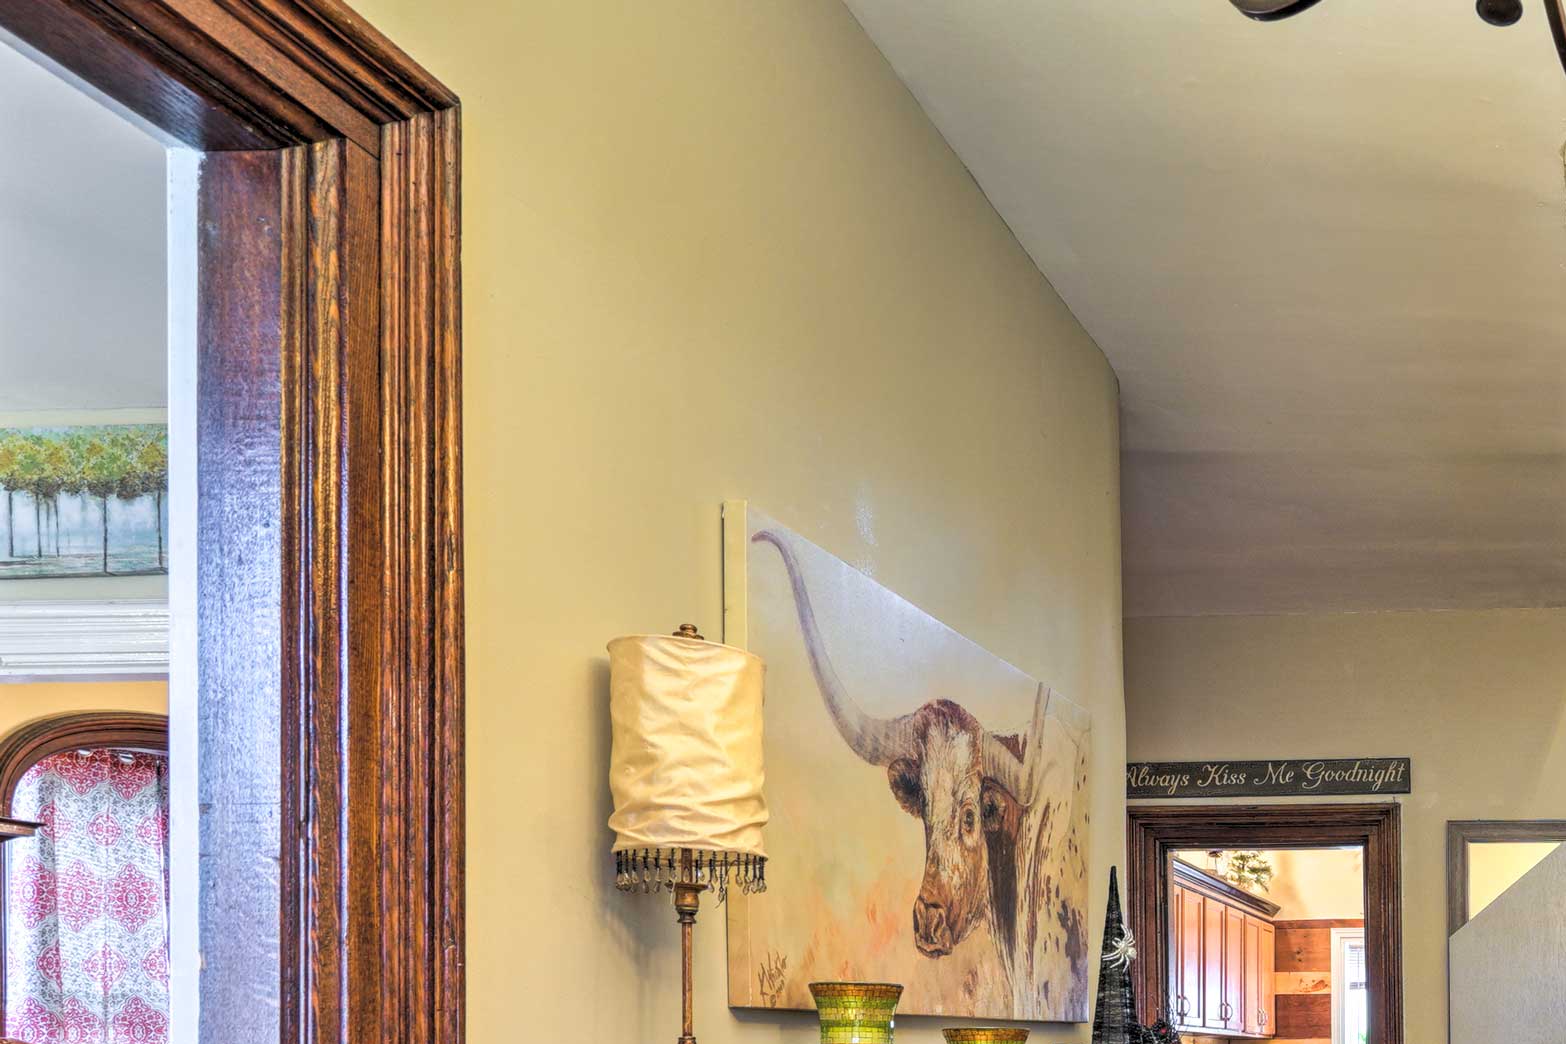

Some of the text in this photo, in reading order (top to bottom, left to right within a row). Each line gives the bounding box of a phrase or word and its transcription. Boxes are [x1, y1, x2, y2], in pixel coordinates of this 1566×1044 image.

[1126, 760, 1405, 796] Always Kiss Me Goodnight
